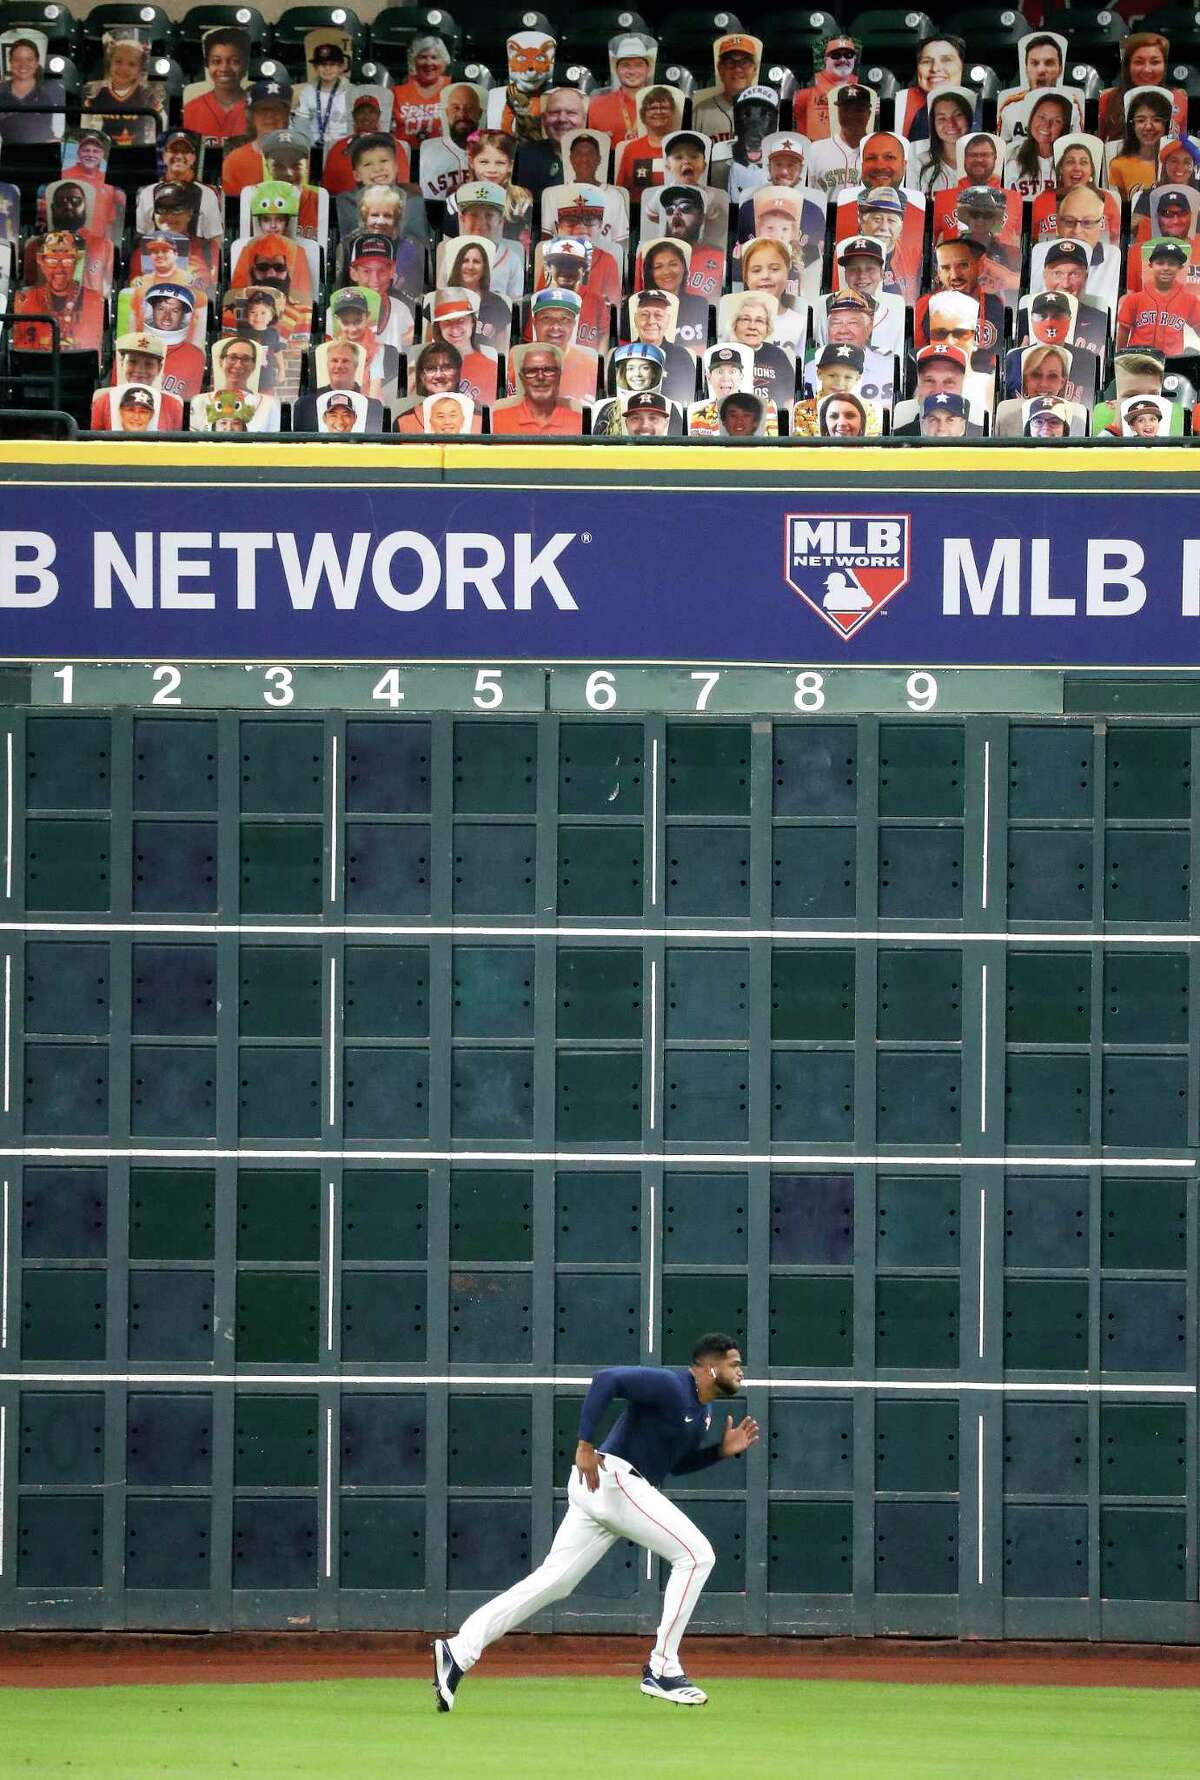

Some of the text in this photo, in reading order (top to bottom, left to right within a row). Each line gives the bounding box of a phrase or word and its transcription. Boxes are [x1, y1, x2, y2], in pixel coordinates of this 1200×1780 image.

[1046, 328, 1057, 338] H
[794, 521, 901, 554] MLB
[94, 531, 578, 611] NETWORK
[794, 556, 901, 567] NETWORK
[943, 539, 1146, 615] MLB
[54, 666, 938, 711] 1 2 3 4 5 6 7 8 9
